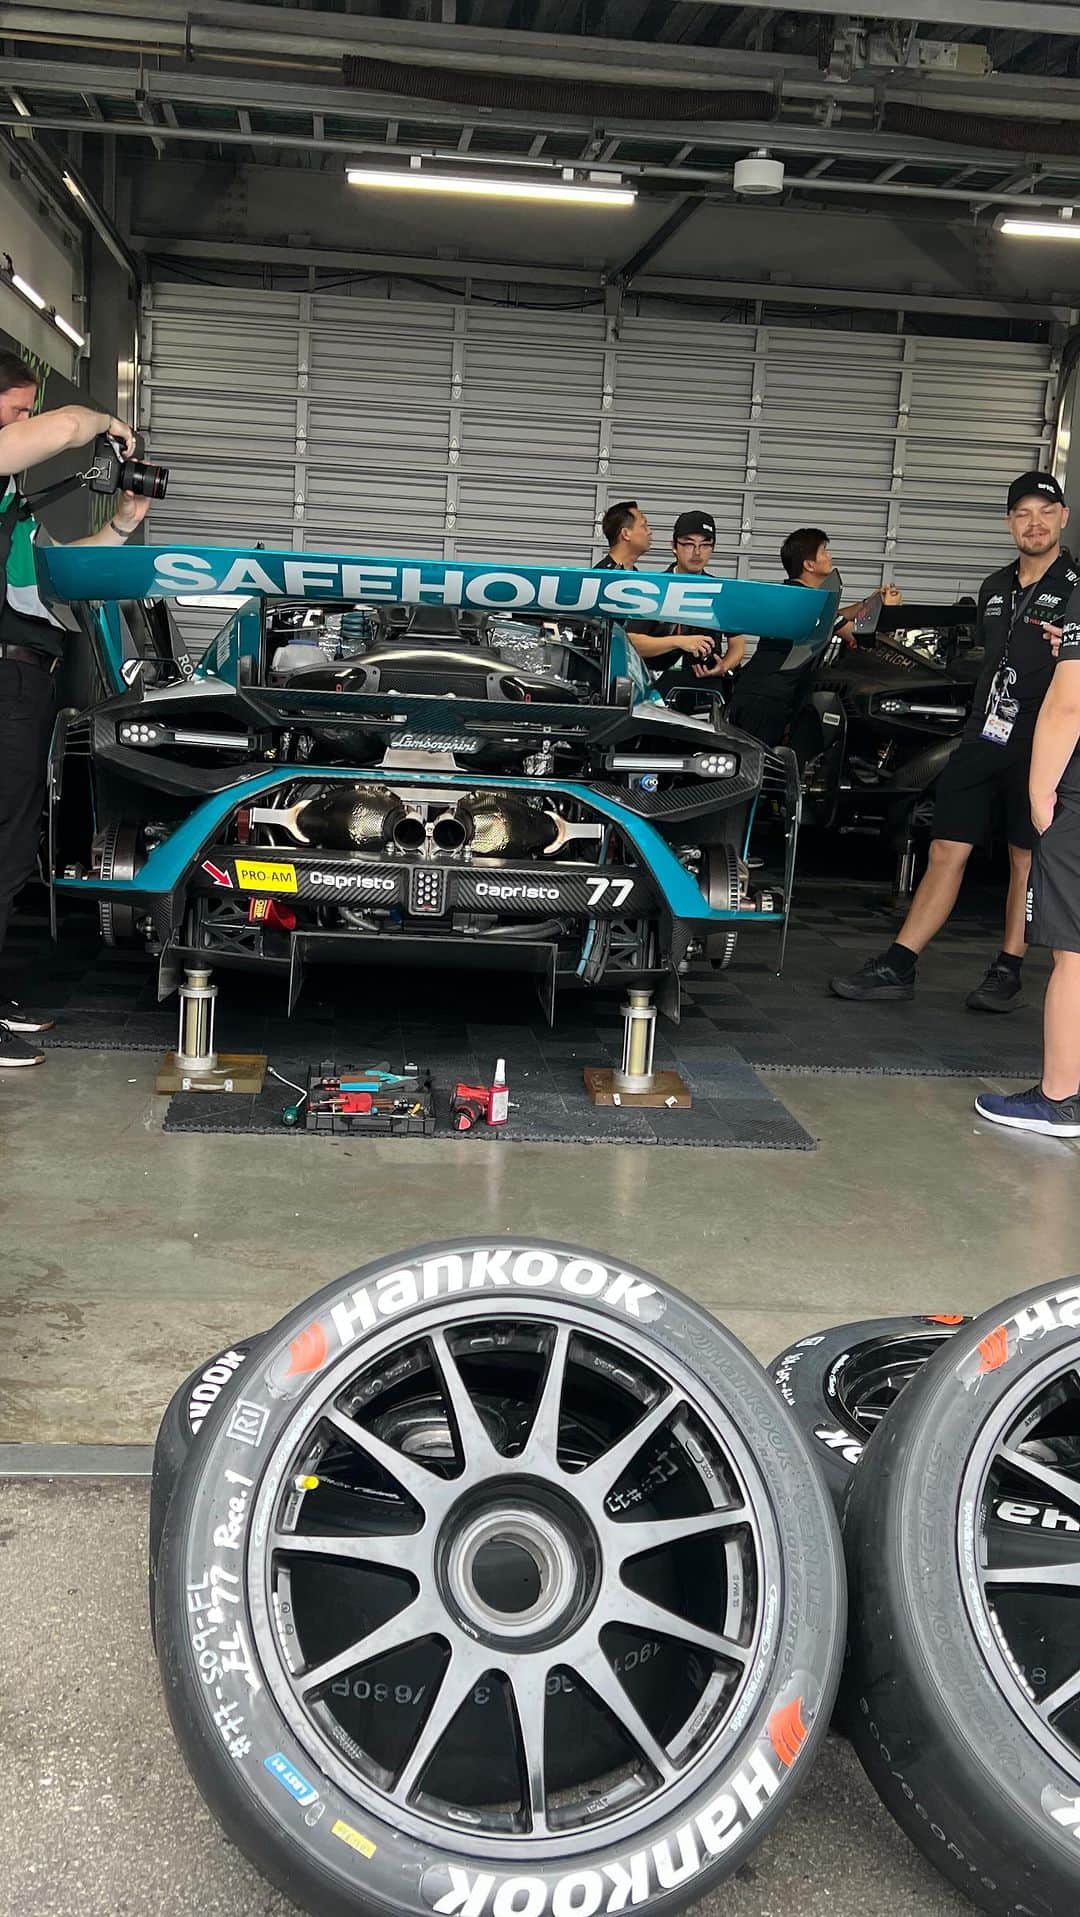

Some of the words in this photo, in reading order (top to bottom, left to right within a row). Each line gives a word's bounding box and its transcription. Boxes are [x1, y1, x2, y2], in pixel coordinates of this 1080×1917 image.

[153, 553, 722, 620] SAFEHOUSE
[391, 735, 477, 752] Lamborghini
[241, 870, 292, 883] PRO-AM
[309, 871, 395, 890] Capristo
[475, 883, 560, 900] Capristo
[585, 877, 635, 907] 77
[330, 1249, 657, 1346] Hankook
